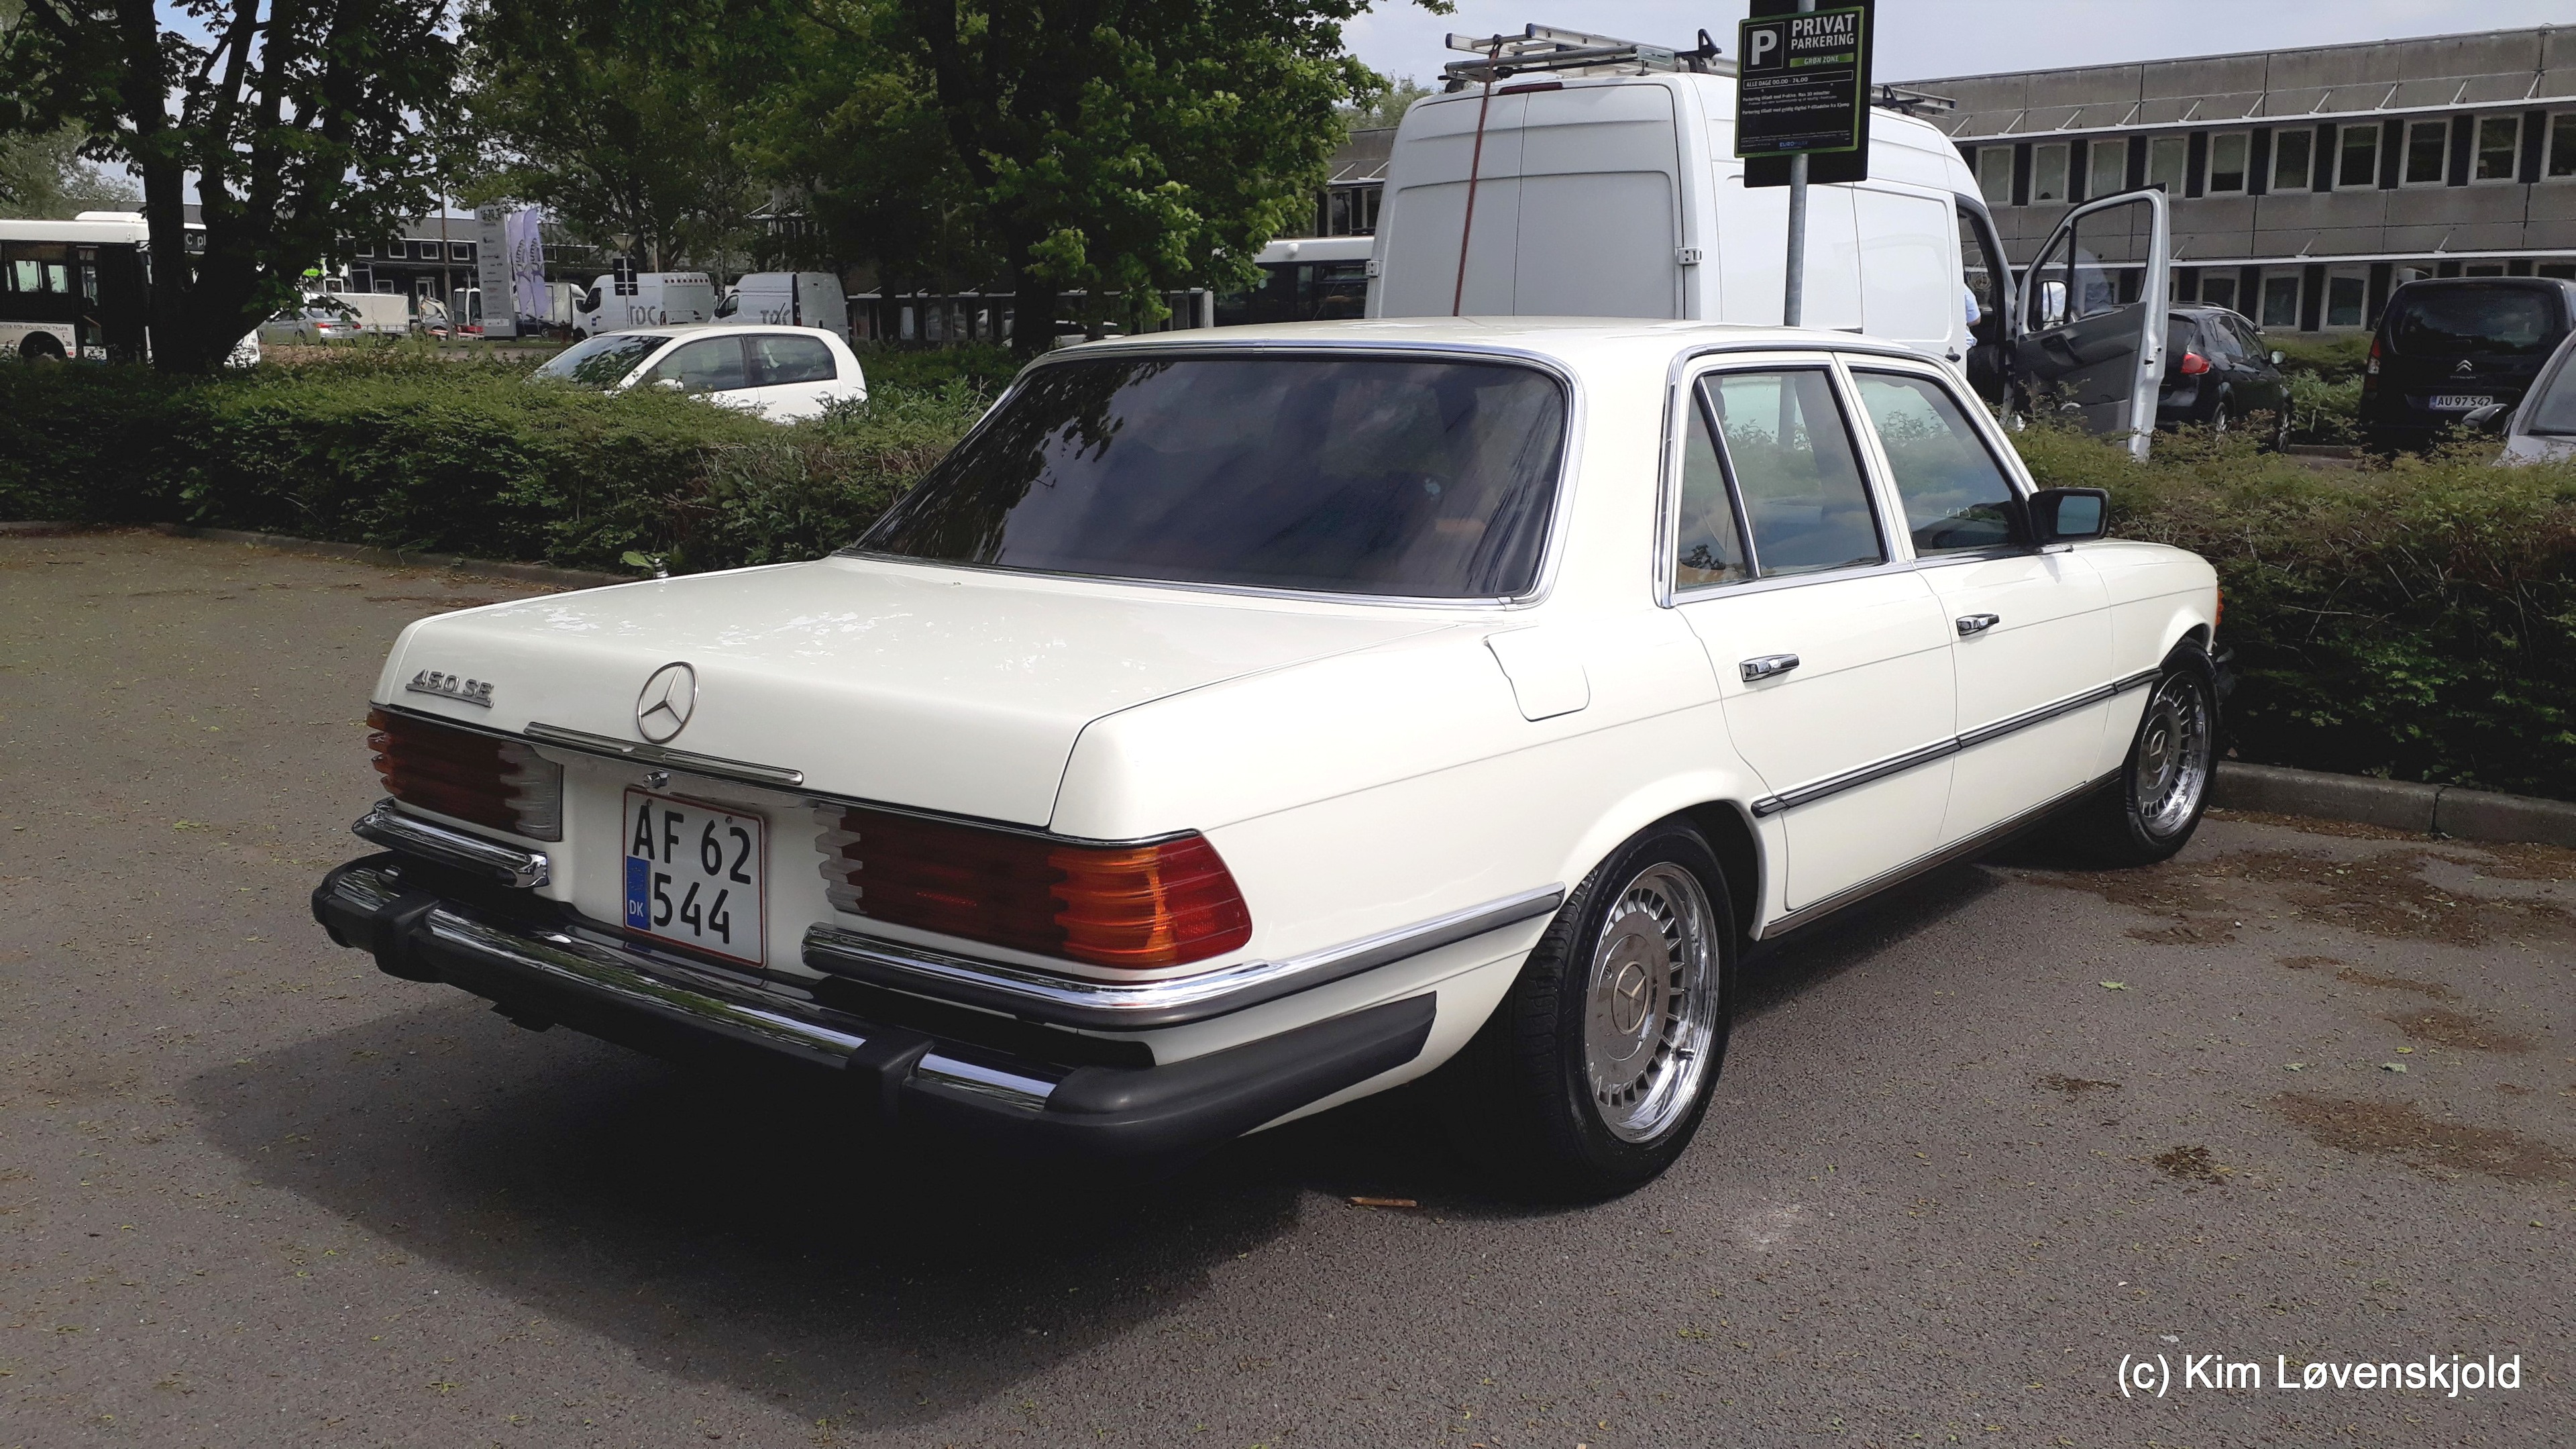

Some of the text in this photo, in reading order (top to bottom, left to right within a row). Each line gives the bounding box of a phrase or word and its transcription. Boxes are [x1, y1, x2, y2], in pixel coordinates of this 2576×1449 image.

[1792, 14, 1855, 37] PRIVAT
[1752, 30, 1776, 66] P
[1791, 34, 1854, 50] PARKERING
[1823, 55, 1839, 63] ZONE
[2437, 396, 2452, 406] AU
[2455, 397, 2467, 406] 97
[413, 669, 494, 699] 450 SE
[633, 805, 751, 885] AF 62
[629, 900, 644, 918] DK
[653, 872, 730, 945] 544
